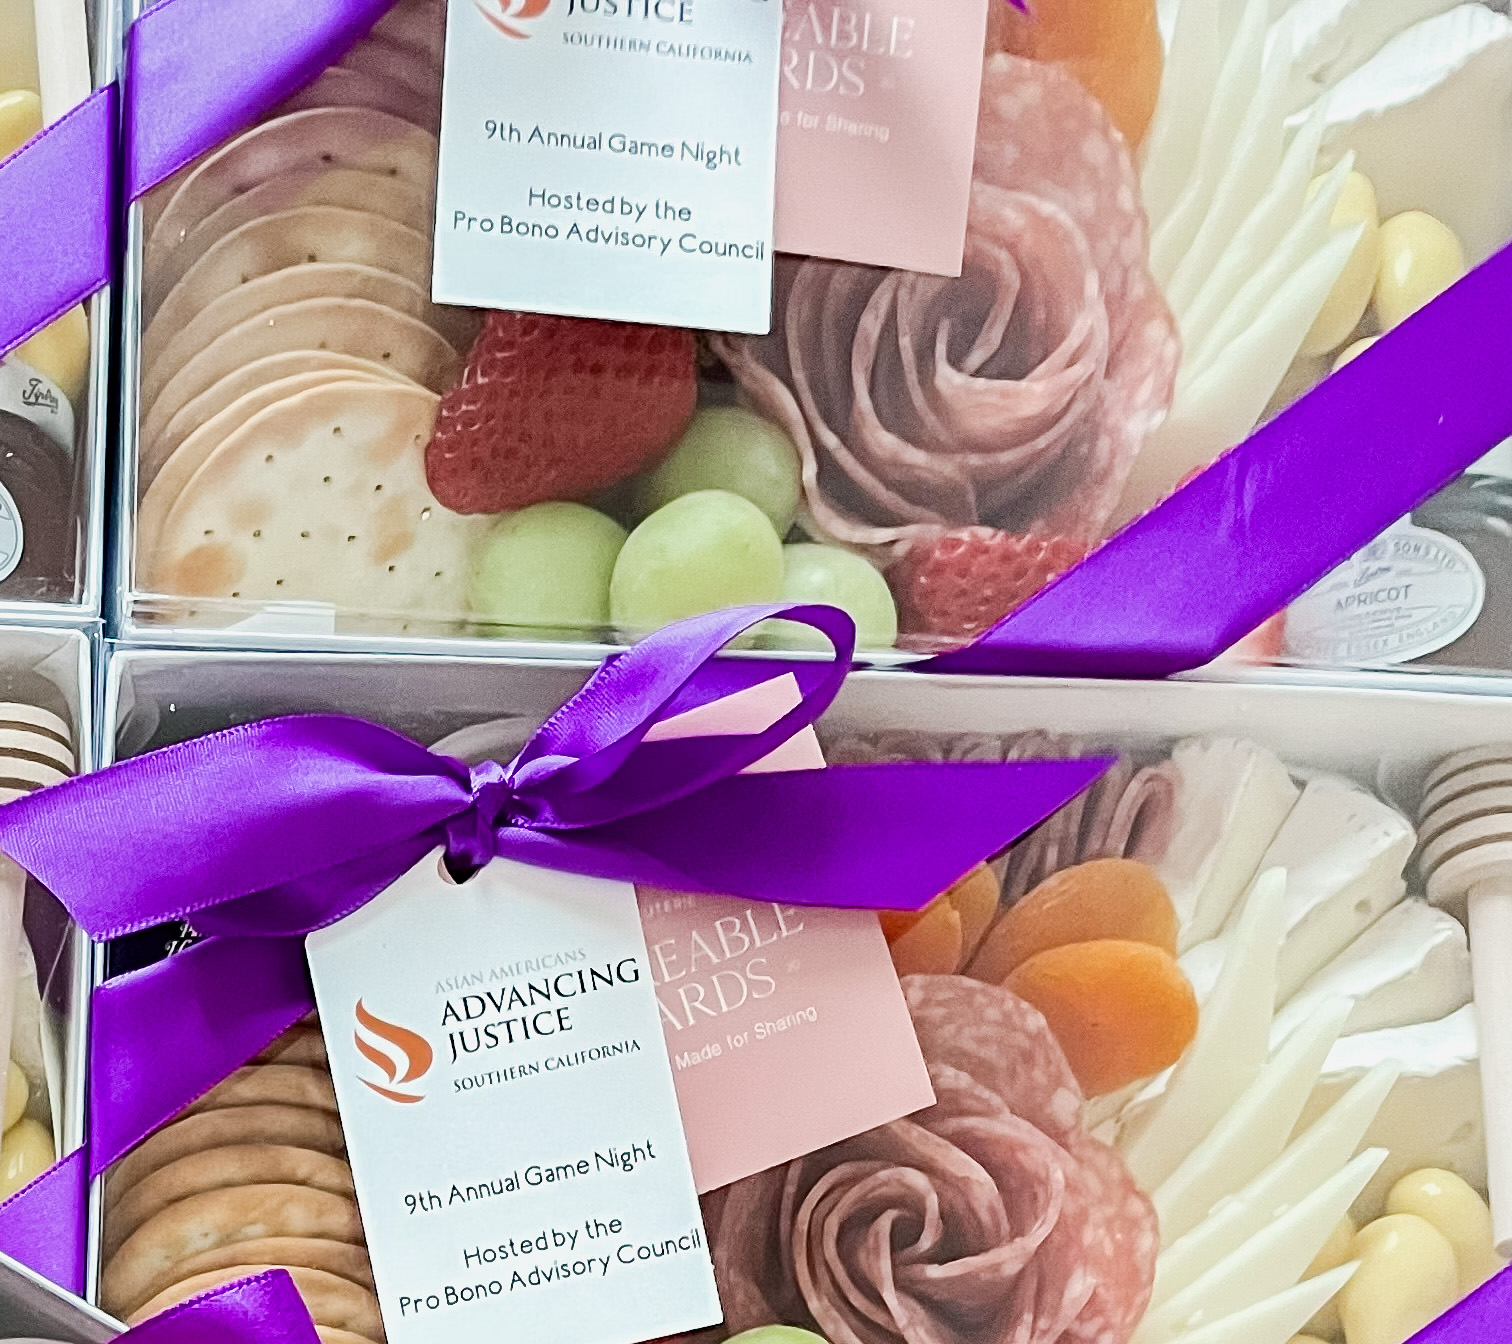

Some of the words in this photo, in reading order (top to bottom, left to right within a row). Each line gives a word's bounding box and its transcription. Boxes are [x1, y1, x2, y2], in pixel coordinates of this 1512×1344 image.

[562, 31, 651, 53] SOUTHERN
[656, 42, 753, 64] CALIFORNIA
[485, 119, 521, 143] 9th
[528, 125, 602, 151] Annual
[608, 134, 673, 158] Game
[681, 141, 742, 170] Night
[528, 187, 614, 214] Hosted
[621, 197, 647, 223] by
[655, 198, 692, 221] the
[453, 211, 494, 233] Pro
[501, 215, 559, 239] Bono
[566, 223, 672, 256] Advisory
[679, 234, 764, 260] Council
[435, 970, 484, 995] ASIAN
[488, 948, 586, 982] AMERICANS
[442, 958, 639, 1026] ADVANCING
[448, 1007, 573, 1065] JUSTICE
[675, 1042, 722, 1070] Made
[727, 1031, 748, 1049] for
[754, 1006, 818, 1040] Sharing
[454, 1062, 540, 1093] SOUTHERN
[545, 1039, 641, 1071] CALIFORNIA
[404, 1191, 442, 1214] 9th
[448, 1170, 521, 1206] Annual
[525, 1159, 589, 1187] Game
[595, 1139, 656, 1173] Night
[463, 1231, 548, 1268] Hosted
[554, 1229, 579, 1251] by
[585, 1217, 622, 1239] the
[399, 1295, 439, 1316] Pro
[444, 1279, 502, 1306] Bono
[510, 1255, 611, 1291] Advisory
[617, 1228, 701, 1264] Council
